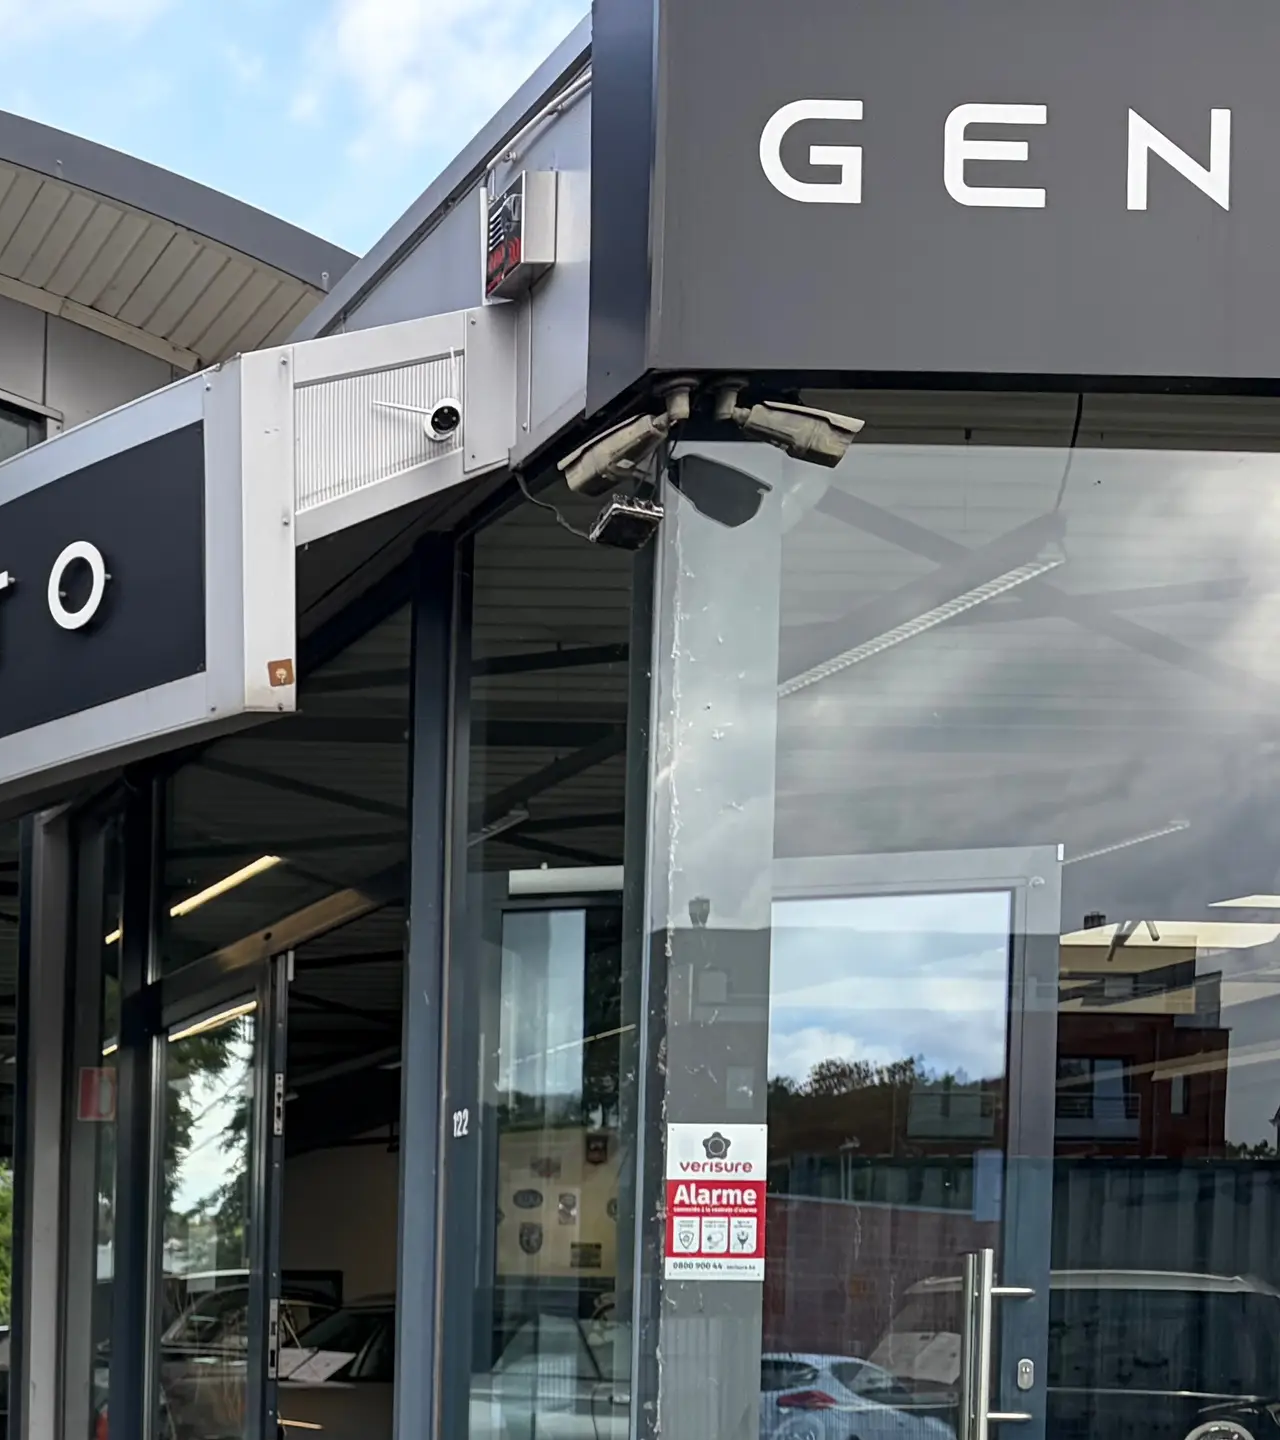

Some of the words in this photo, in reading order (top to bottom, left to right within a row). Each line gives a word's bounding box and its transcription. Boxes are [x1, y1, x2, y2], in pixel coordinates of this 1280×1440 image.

[758, 98, 1232, 211] GEN
[452, 1107, 469, 1138] 122
[680, 1161, 752, 1173] verisure
[673, 1183, 758, 1206] Alarme
[673, 1261, 693, 1269] 0800
